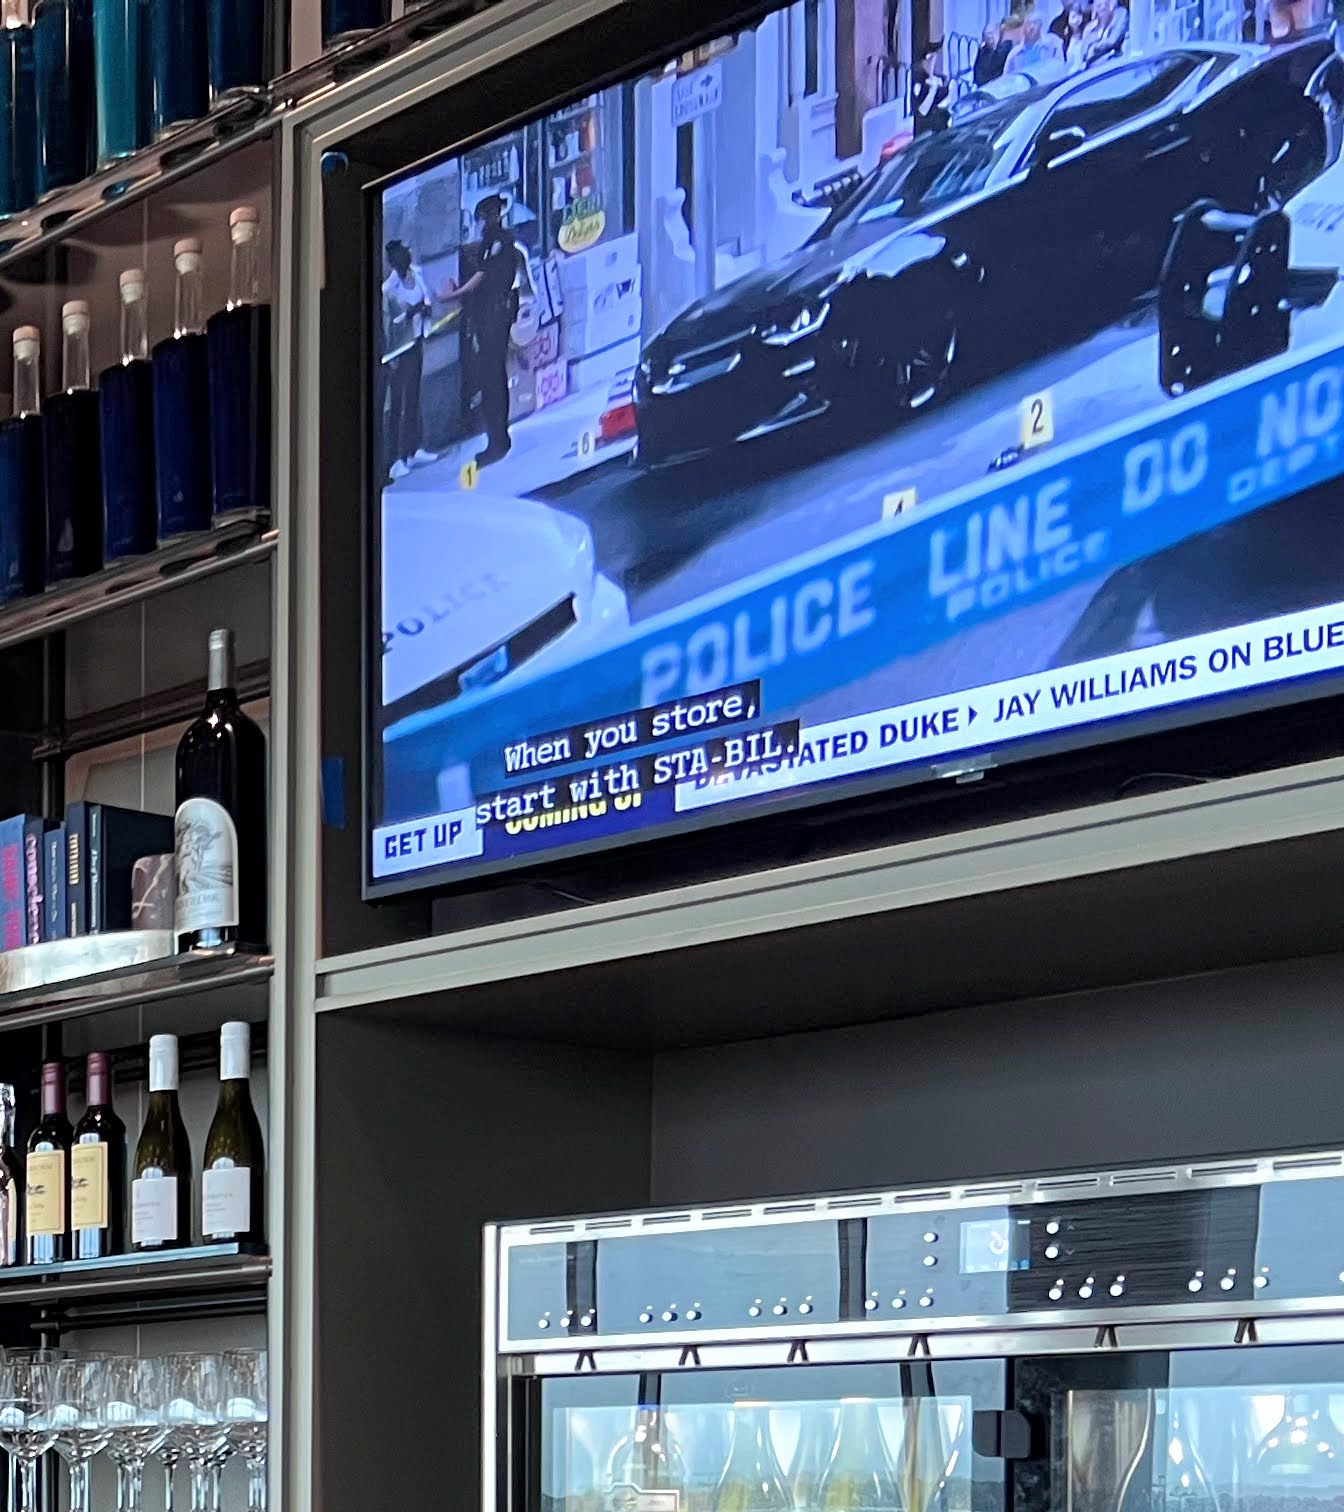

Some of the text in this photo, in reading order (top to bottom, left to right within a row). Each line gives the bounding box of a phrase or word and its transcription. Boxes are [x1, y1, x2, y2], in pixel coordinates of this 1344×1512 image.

[1030, 398, 1045, 434] 2
[640, 364, 1344, 708] POLICE LINE DO NO
[879, 706, 960, 749] DUKE
[993, 690, 1042, 724] JAY
[1050, 655, 1198, 709] WILLIAMS
[1208, 640, 1251, 674] ON
[1263, 620, 1344, 663] BLUE
[504, 692, 757, 774] When you store,
[476, 784, 556, 825] start
[569, 763, 640, 803] with
[654, 730, 797, 785] STA-BIL.
[385, 819, 464, 859] GET UP
